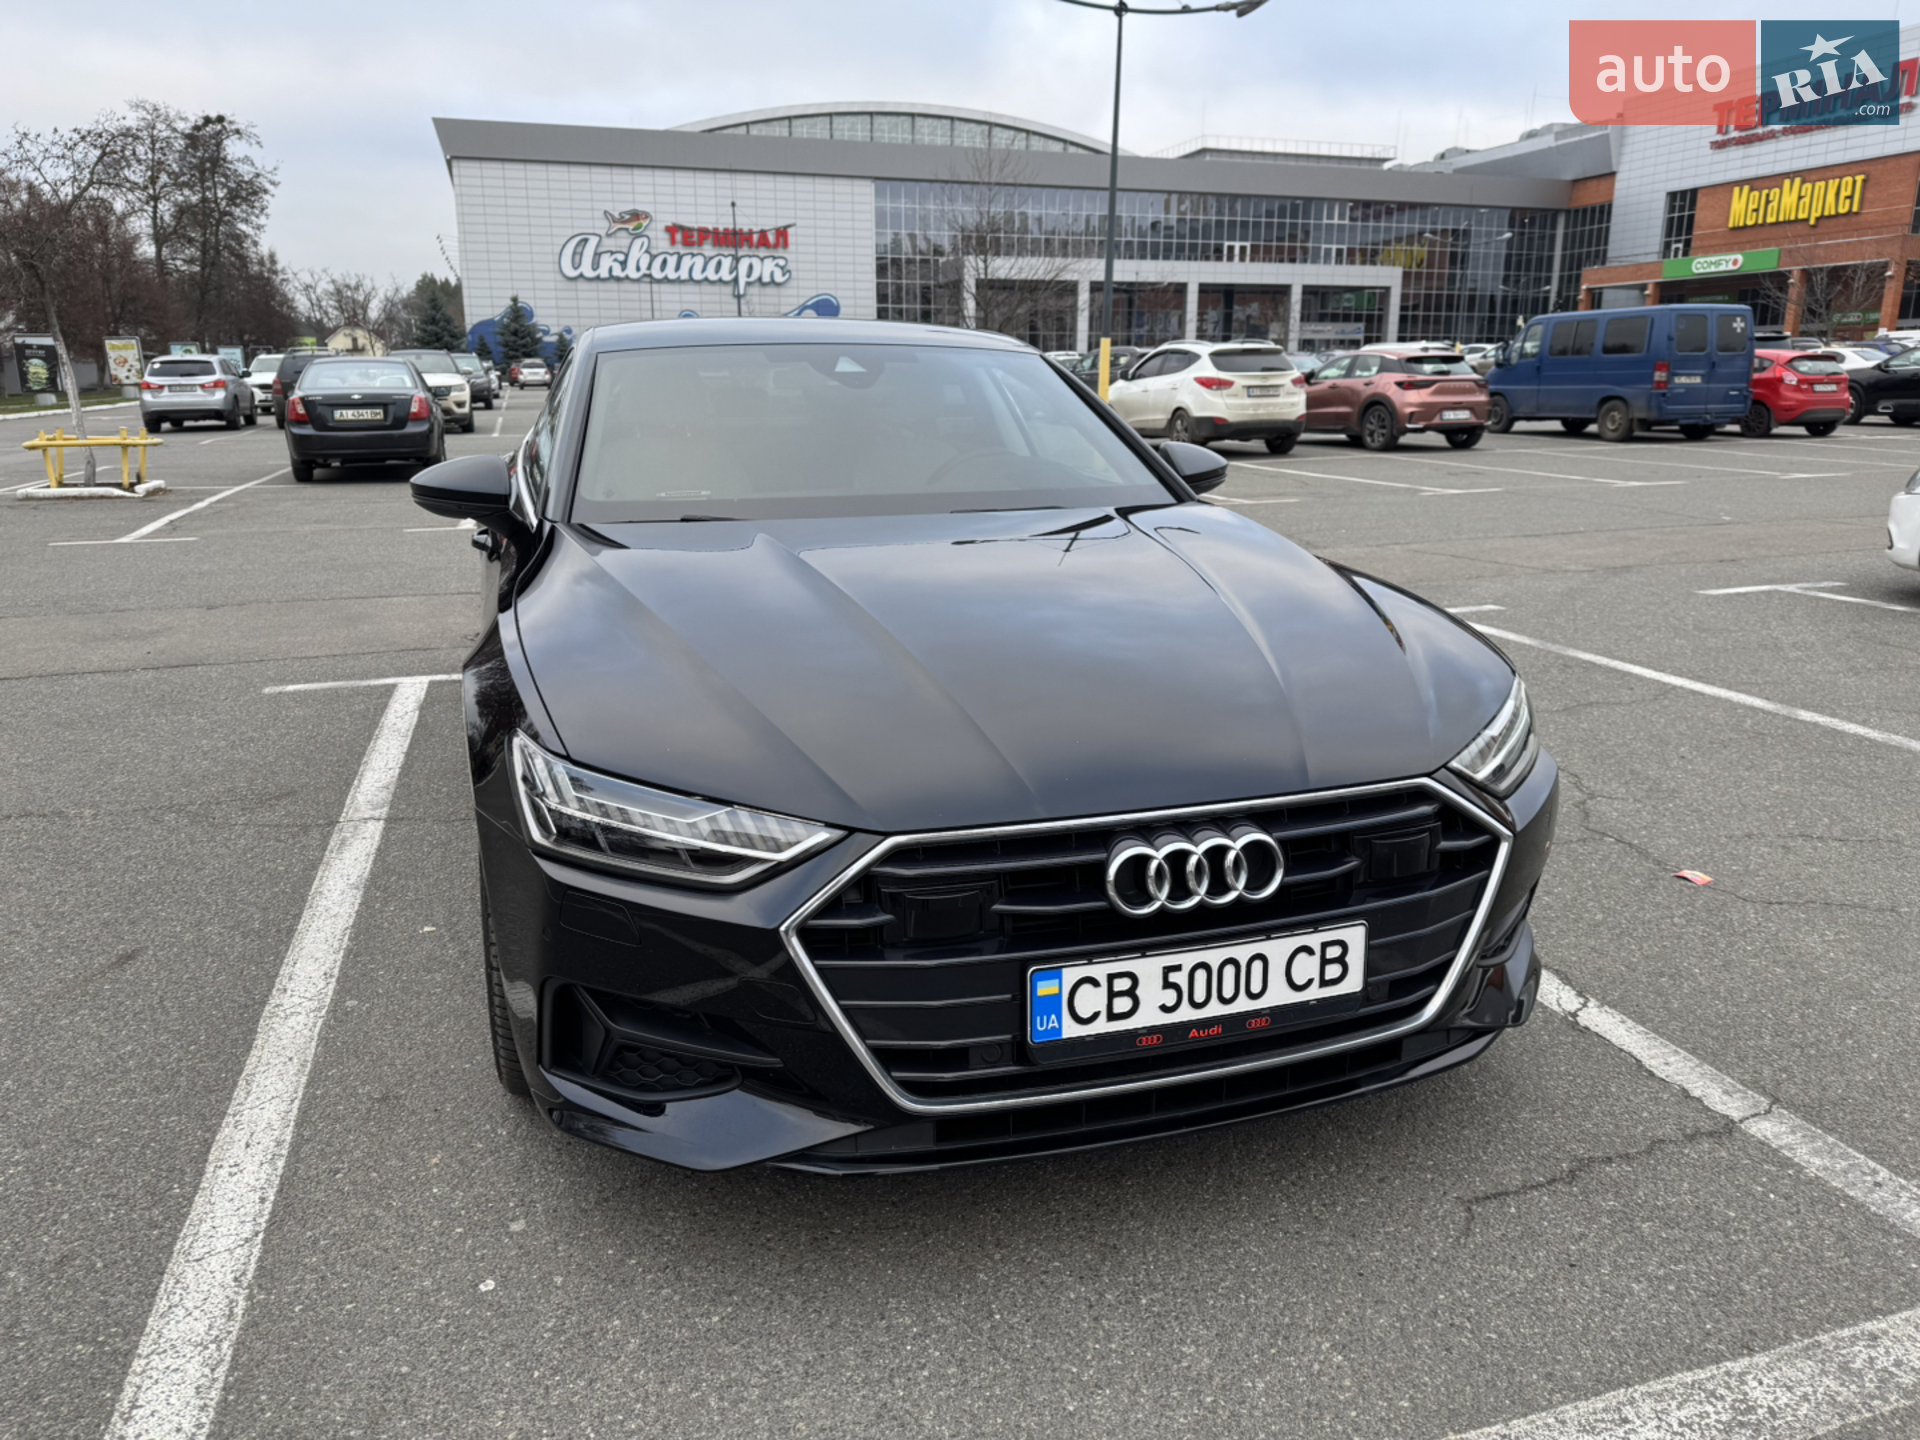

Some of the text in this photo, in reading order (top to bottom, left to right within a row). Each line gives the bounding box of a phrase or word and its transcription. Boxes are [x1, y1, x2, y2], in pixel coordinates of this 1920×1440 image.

[1728, 174, 1867, 230] МегаМаркет
[665, 225, 790, 249] ТЕРМІНАЛ
[559, 232, 792, 298] Аквапарк
[1693, 257, 1732, 272] COMFY
[1067, 938, 1349, 1026] CB 5000 CB
[1036, 1014, 1060, 1032] UA
[1188, 1024, 1222, 1039] Audi
